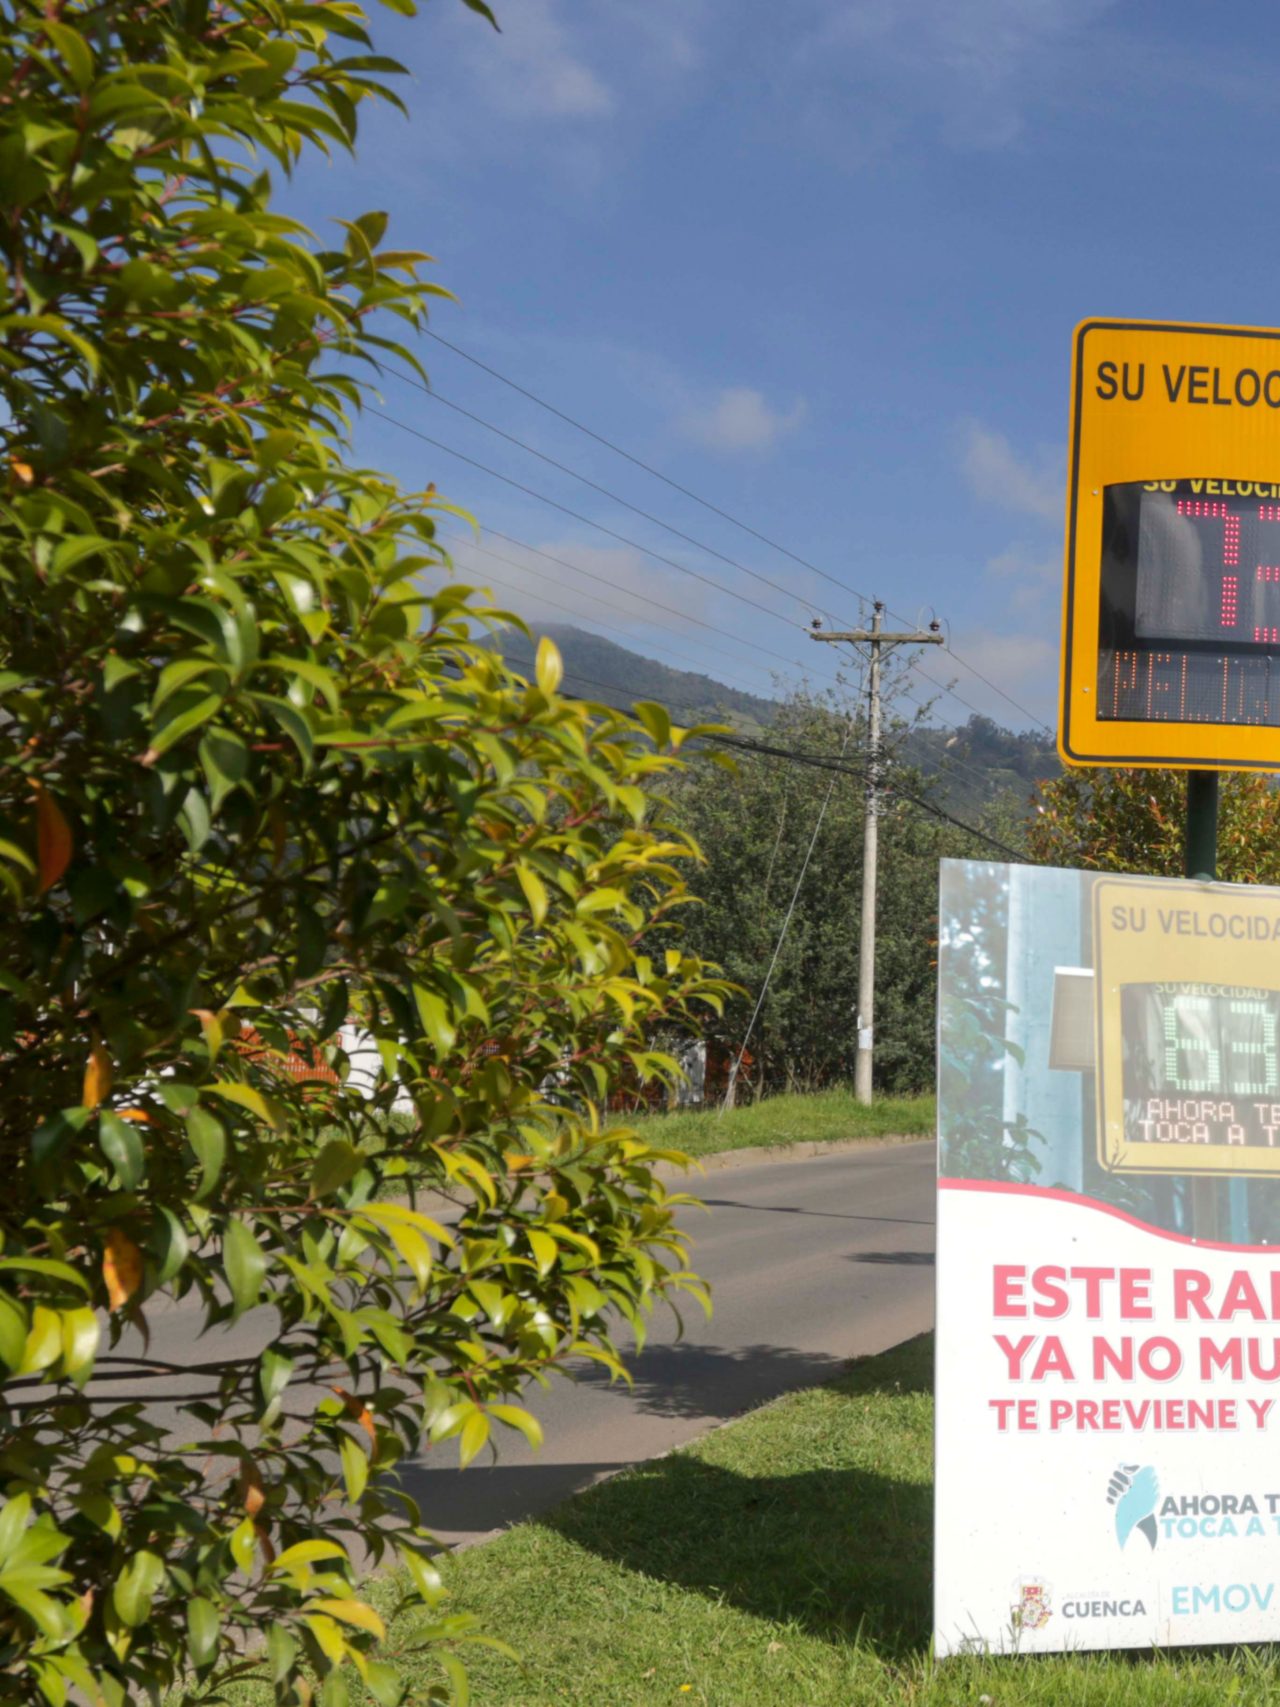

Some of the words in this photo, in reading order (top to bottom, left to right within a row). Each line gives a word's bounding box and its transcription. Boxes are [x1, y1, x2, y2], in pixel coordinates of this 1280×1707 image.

[1095, 361, 1145, 401] SU
[1112, 905, 1147, 933] SU
[1155, 983, 1178, 994] SU
[1181, 983, 1269, 1000] VELOCIDAD
[1164, 996, 1277, 1094] 63
[1147, 1098, 1234, 1122] AHORA
[1139, 1120, 1210, 1144] TOCA
[1228, 1124, 1244, 1145] A
[991, 1264, 1153, 1320] ESTE
[992, 1334, 1076, 1381] YA
[1092, 1336, 1183, 1382] NO
[988, 1400, 1038, 1430] TE
[1049, 1399, 1238, 1430] PREVIENE
[1249, 1398, 1276, 1429] Y
[1159, 1495, 1259, 1516] AHORA
[1160, 1516, 1237, 1538] TOCA
[1245, 1515, 1272, 1536] A
[1062, 1600, 1146, 1618] CUENCA
[1171, 1583, 1274, 1615] EMOV
